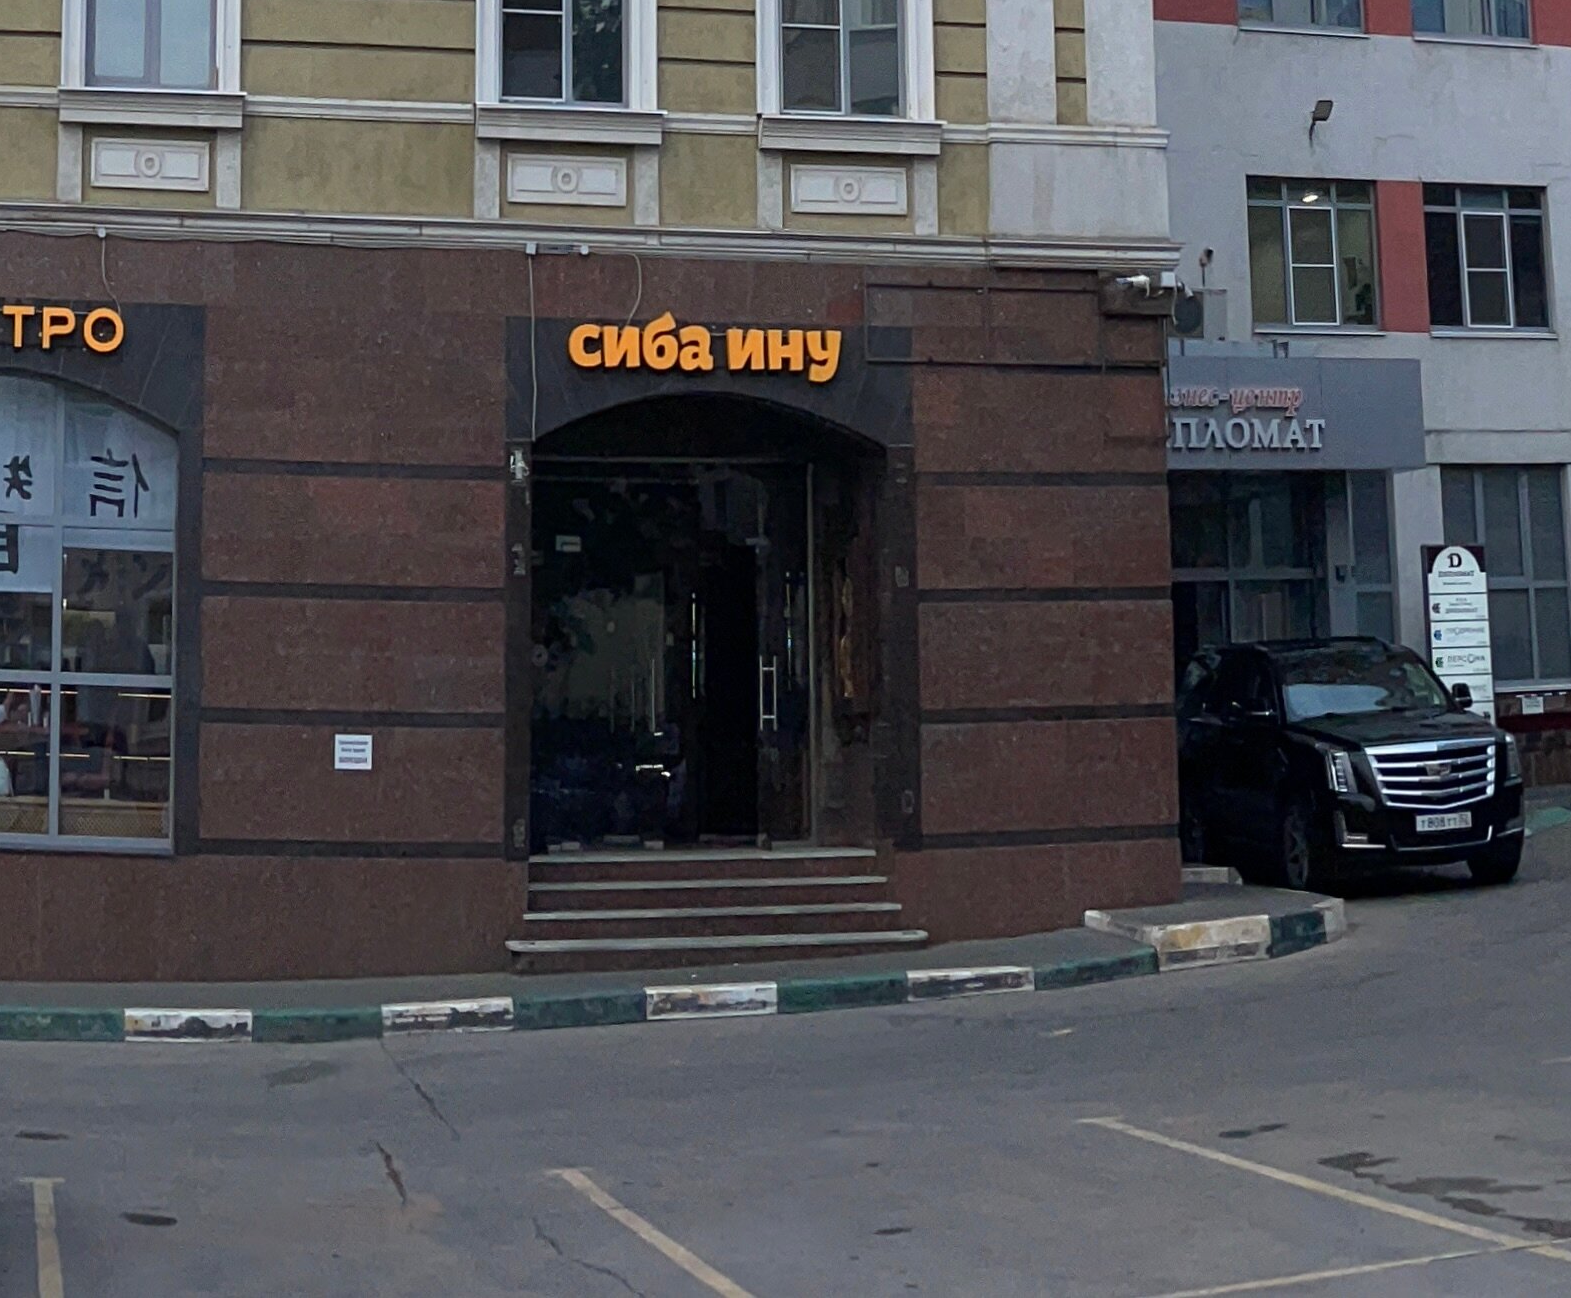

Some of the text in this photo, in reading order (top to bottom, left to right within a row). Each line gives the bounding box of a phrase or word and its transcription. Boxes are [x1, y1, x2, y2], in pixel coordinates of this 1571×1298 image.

[569, 311, 842, 383] сиба ину
[1167, 417, 1325, 449] ПЛОМАТ
